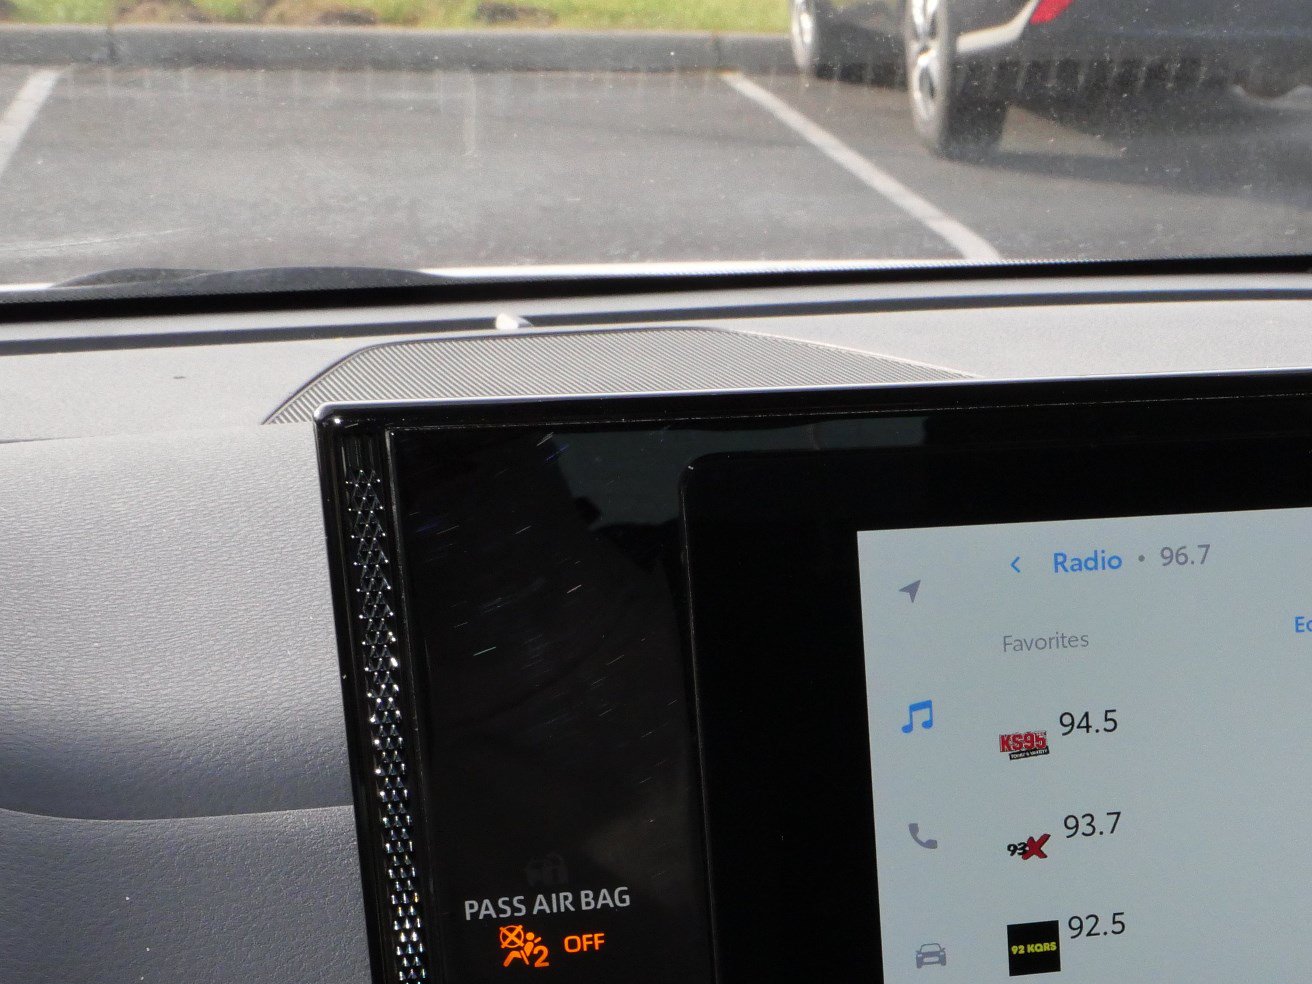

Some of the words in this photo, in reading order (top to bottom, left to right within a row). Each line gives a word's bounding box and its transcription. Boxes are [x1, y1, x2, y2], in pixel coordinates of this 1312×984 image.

[1053, 550, 1123, 573] Radio
[1160, 544, 1211, 567] 96.7
[1002, 632, 1090, 653] Favorites
[1059, 709, 1118, 736] 94.5
[1063, 812, 1122, 838] 93.7
[465, 896, 526, 920] PASS
[533, 892, 576, 914] AIR
[580, 886, 631, 911] BAG
[1067, 912, 1126, 939] 92.5
[563, 933, 605, 953] OFF
[1011, 945, 1025, 955] 92
[1027, 942, 1057, 953] KQRS
